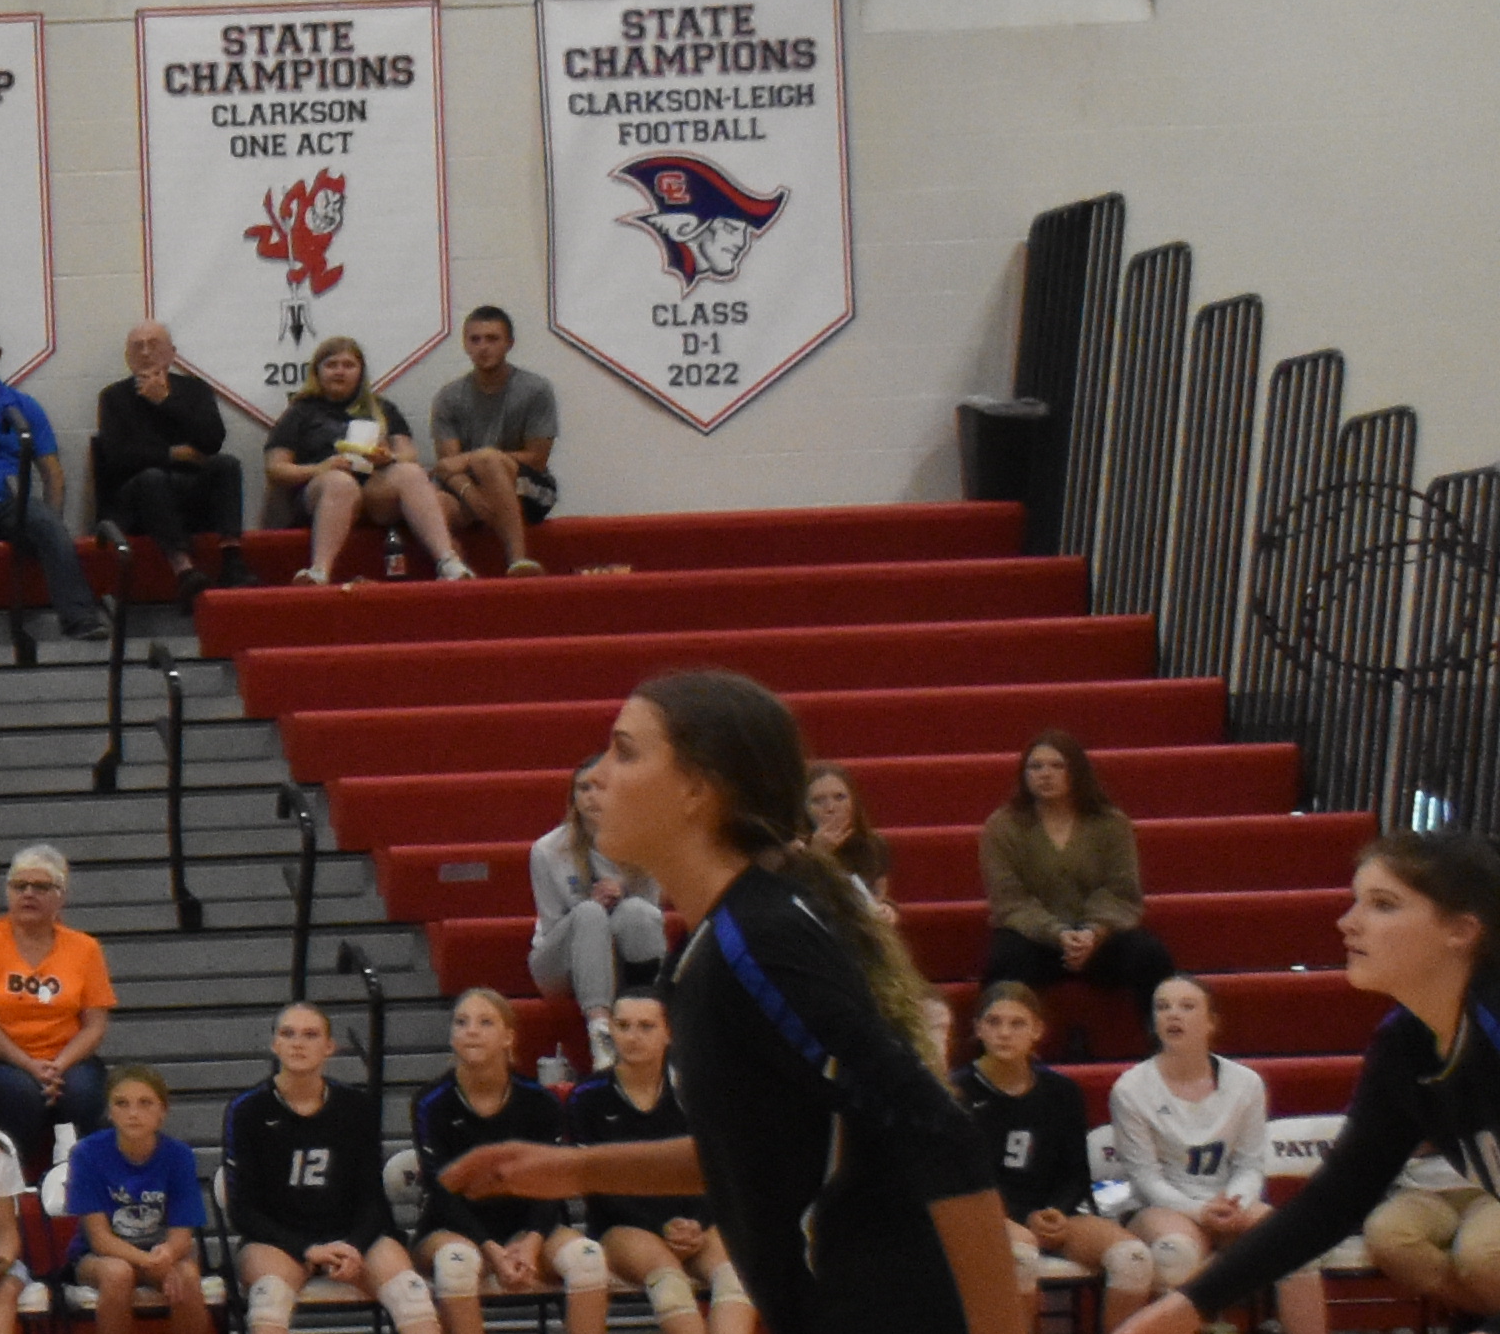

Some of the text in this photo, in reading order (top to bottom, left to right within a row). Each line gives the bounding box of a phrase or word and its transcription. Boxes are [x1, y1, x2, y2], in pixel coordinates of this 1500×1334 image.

[221, 20, 355, 57] STATE
[621, 3, 756, 41] STATE
[564, 37, 817, 80] CHAMPIONS
[163, 54, 415, 97] CHAMPIONS
[211, 99, 368, 127] CLARKSON
[568, 83, 815, 116] CLARKSON-LEIGH
[230, 131, 354, 158] ONE ACT
[618, 117, 766, 146] FOOTBALL
[651, 301, 749, 327] CLASS
[681, 331, 721, 356] D-1
[667, 362, 739, 386] 2022
[1003, 1130, 1034, 1168] 9
[1185, 1140, 1225, 1176] 17
[1271, 1138, 1334, 1159] PATR
[287, 1148, 330, 1187] 12
